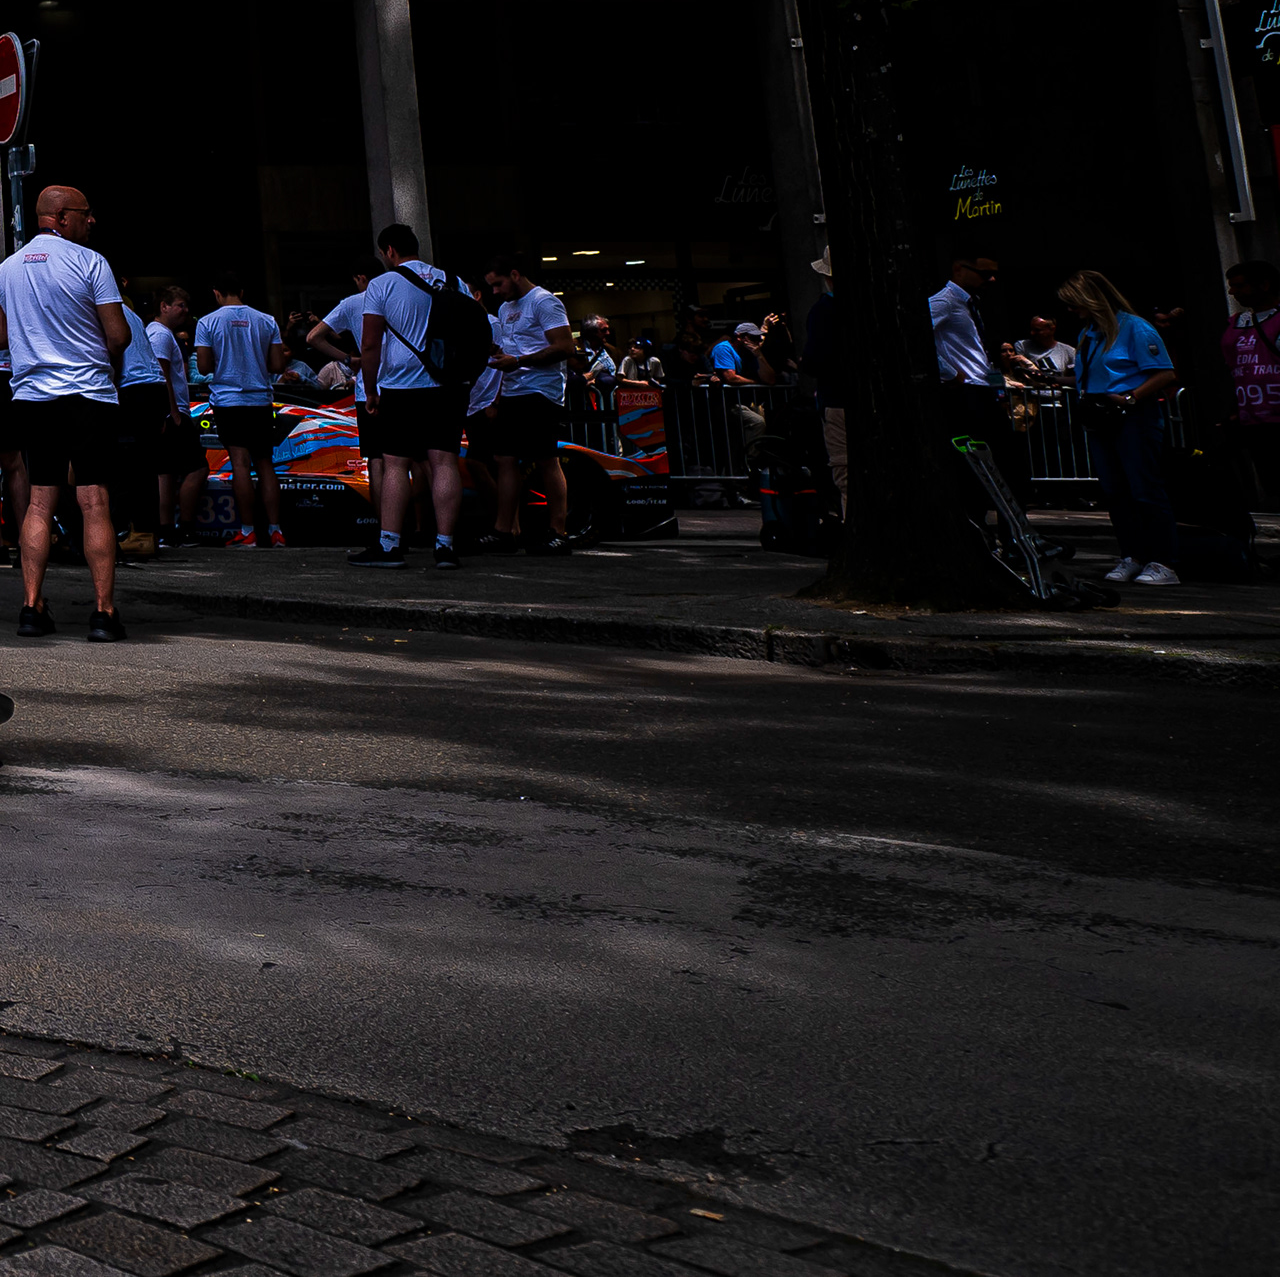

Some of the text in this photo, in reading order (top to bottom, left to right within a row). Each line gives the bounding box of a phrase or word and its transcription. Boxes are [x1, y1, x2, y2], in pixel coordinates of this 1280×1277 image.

[958, 164, 974, 178] Les
[948, 169, 998, 191] Lunettes
[972, 187, 984, 201] de
[954, 195, 1003, 220] Martin
[1236, 353, 1259, 365] EDIA
[1253, 364, 1280, 375] TRAC
[1235, 383, 1280, 407] 095
[280, 482, 346, 491] nster.com
[196, 494, 237, 524] 33
